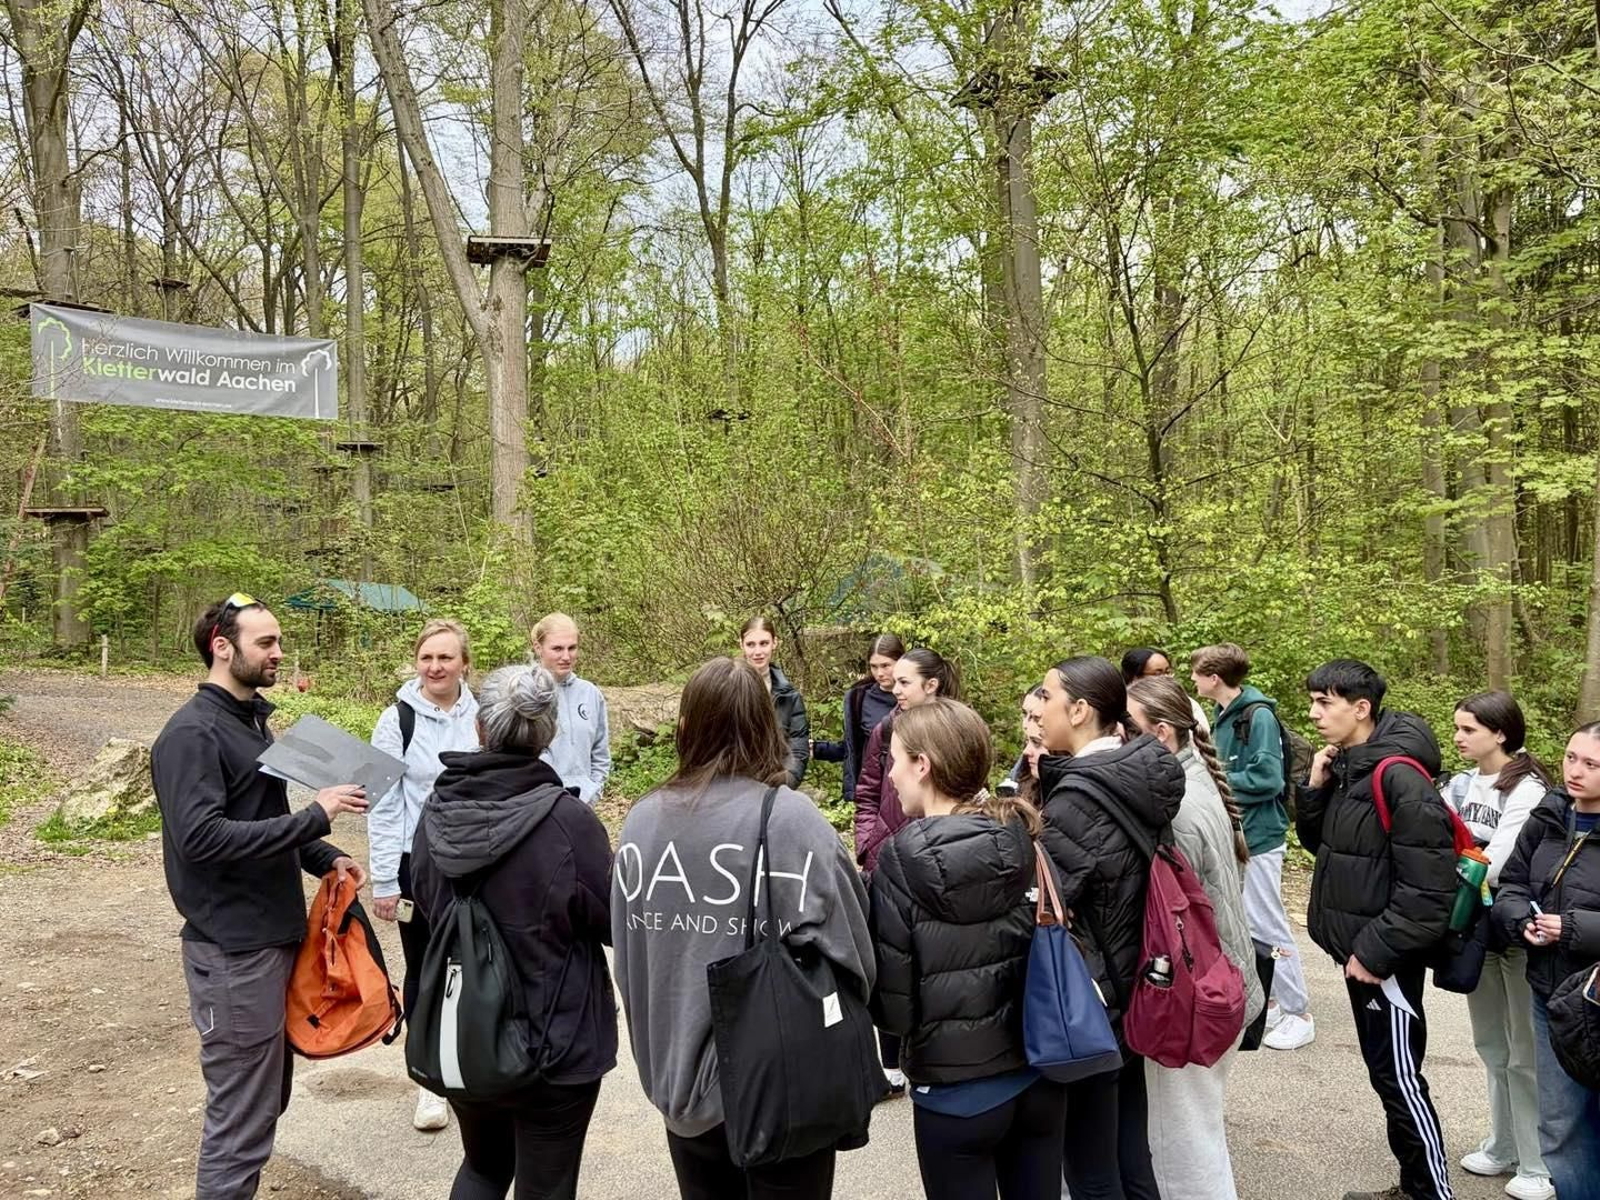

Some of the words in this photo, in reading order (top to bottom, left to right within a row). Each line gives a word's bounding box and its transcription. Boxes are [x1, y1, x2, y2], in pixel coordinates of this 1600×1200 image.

[82, 337, 159, 361] Herzlich
[165, 346, 271, 373] Willkommen
[275, 358, 296, 375] im
[82, 356, 210, 387] Kletterwald
[216, 370, 297, 393] Aachen
[616, 841, 814, 913] DASH
[670, 913, 718, 934] AND
